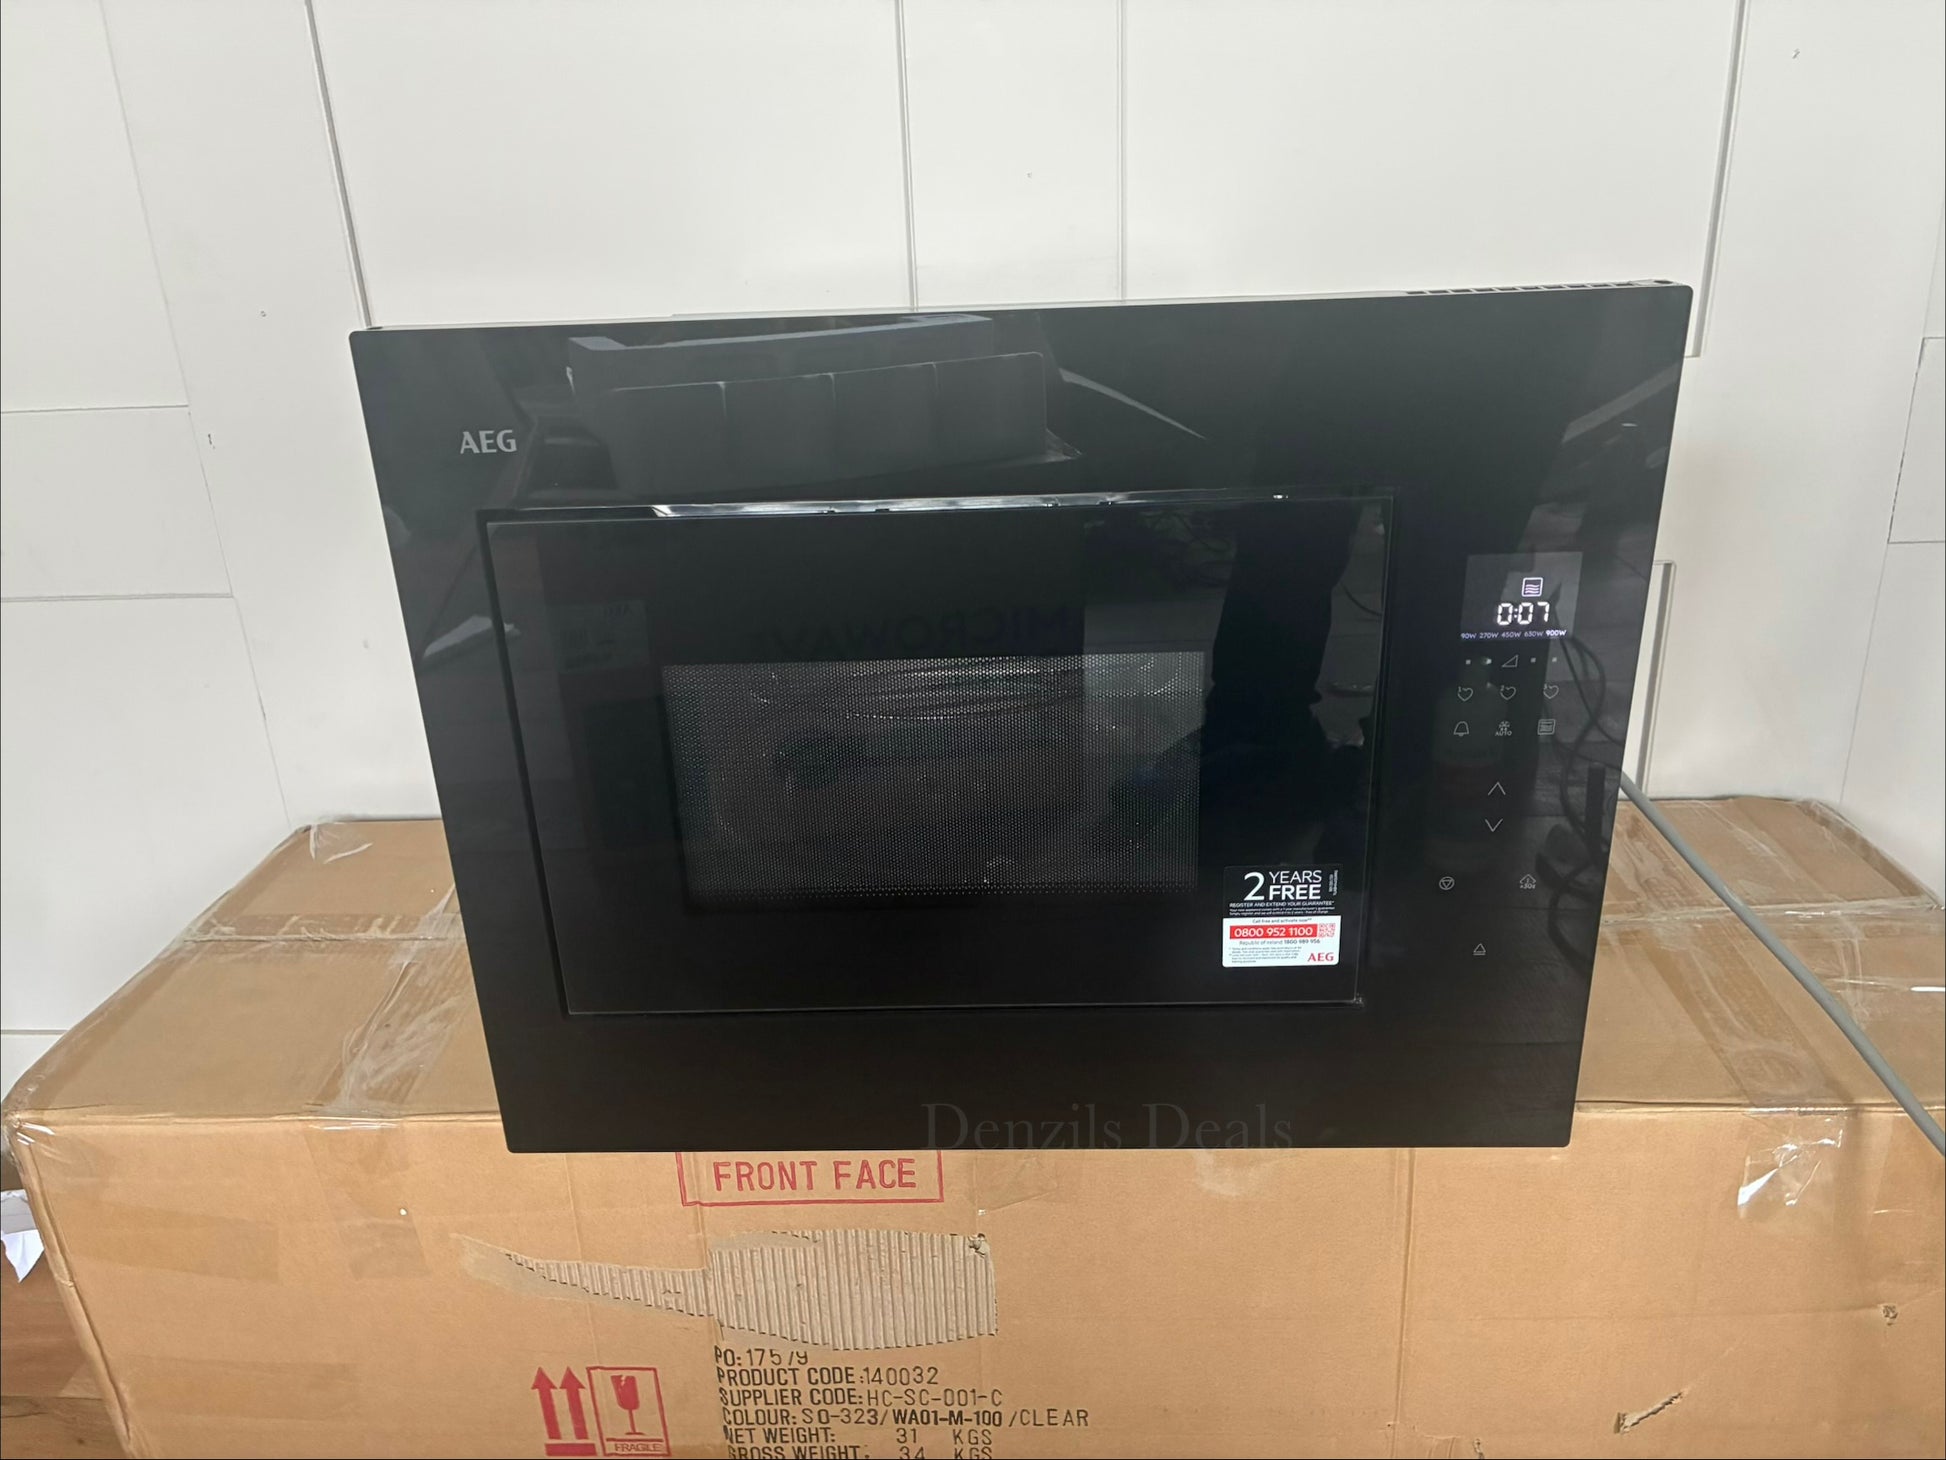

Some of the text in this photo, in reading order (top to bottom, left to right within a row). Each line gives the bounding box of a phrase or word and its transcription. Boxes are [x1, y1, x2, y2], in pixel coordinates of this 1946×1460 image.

[460, 429, 517, 454] AEG
[1496, 601, 1550, 625] 0:07
[1545, 629, 1567, 637] 900W
[1244, 872, 1265, 901] 2
[1269, 870, 1322, 884] YEARS
[1269, 884, 1321, 900] FREE
[1234, 926, 1313, 937] 0800 952 1100
[1307, 952, 1334, 962] AEG
[713, 1158, 916, 1191] FRONT FACE
[716, 1366, 800, 1387] PRODUCT
[719, 1387, 802, 1407] SUPPLIER
[723, 1426, 993, 1445] NET WEIGHT: 31 KGS
[614, 1443, 664, 1452] FRAGILE
